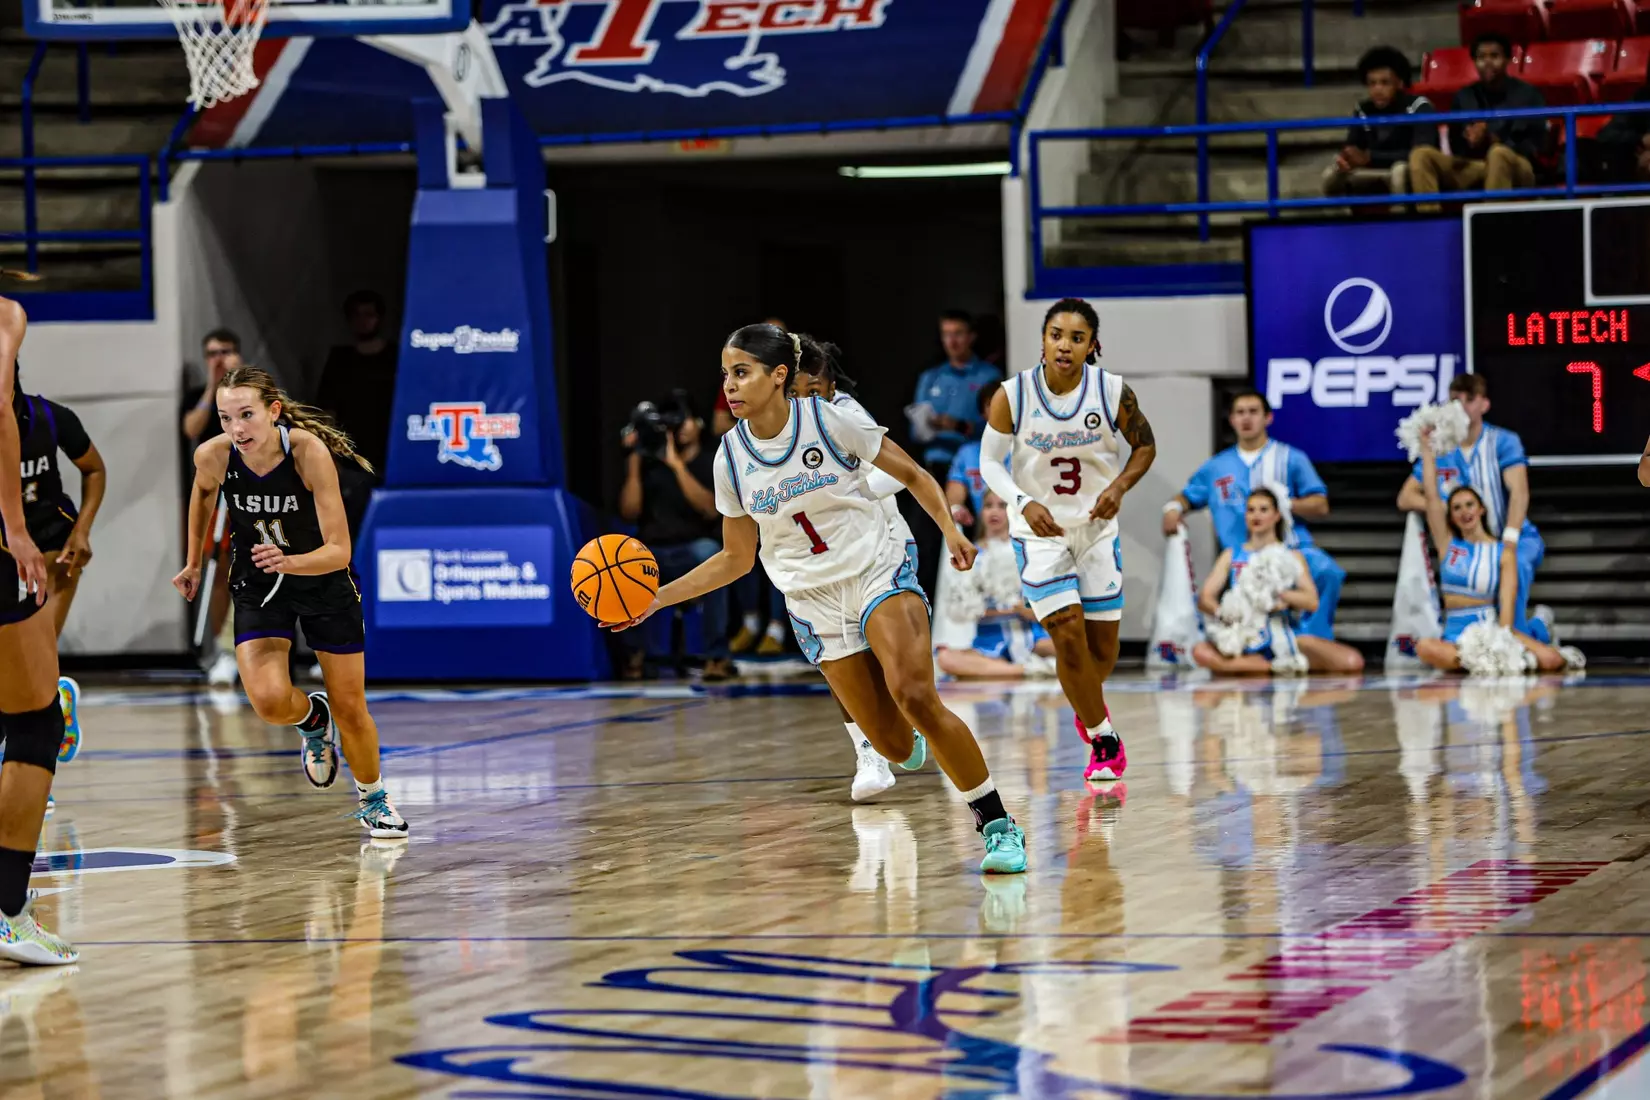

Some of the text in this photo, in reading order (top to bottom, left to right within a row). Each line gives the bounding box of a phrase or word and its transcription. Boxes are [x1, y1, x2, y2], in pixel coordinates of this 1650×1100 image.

[1266, 353, 1456, 409] PEPSI
[1566, 361, 1603, 433] 7
[20, 454, 50, 478] UA
[1050, 456, 1082, 495] 3
[233, 493, 300, 513] LSUA
[750, 469, 839, 515] Lady Techsters
[253, 519, 291, 547] 11
[792, 511, 829, 555] 1
[483, 581, 549, 600] Medicine
